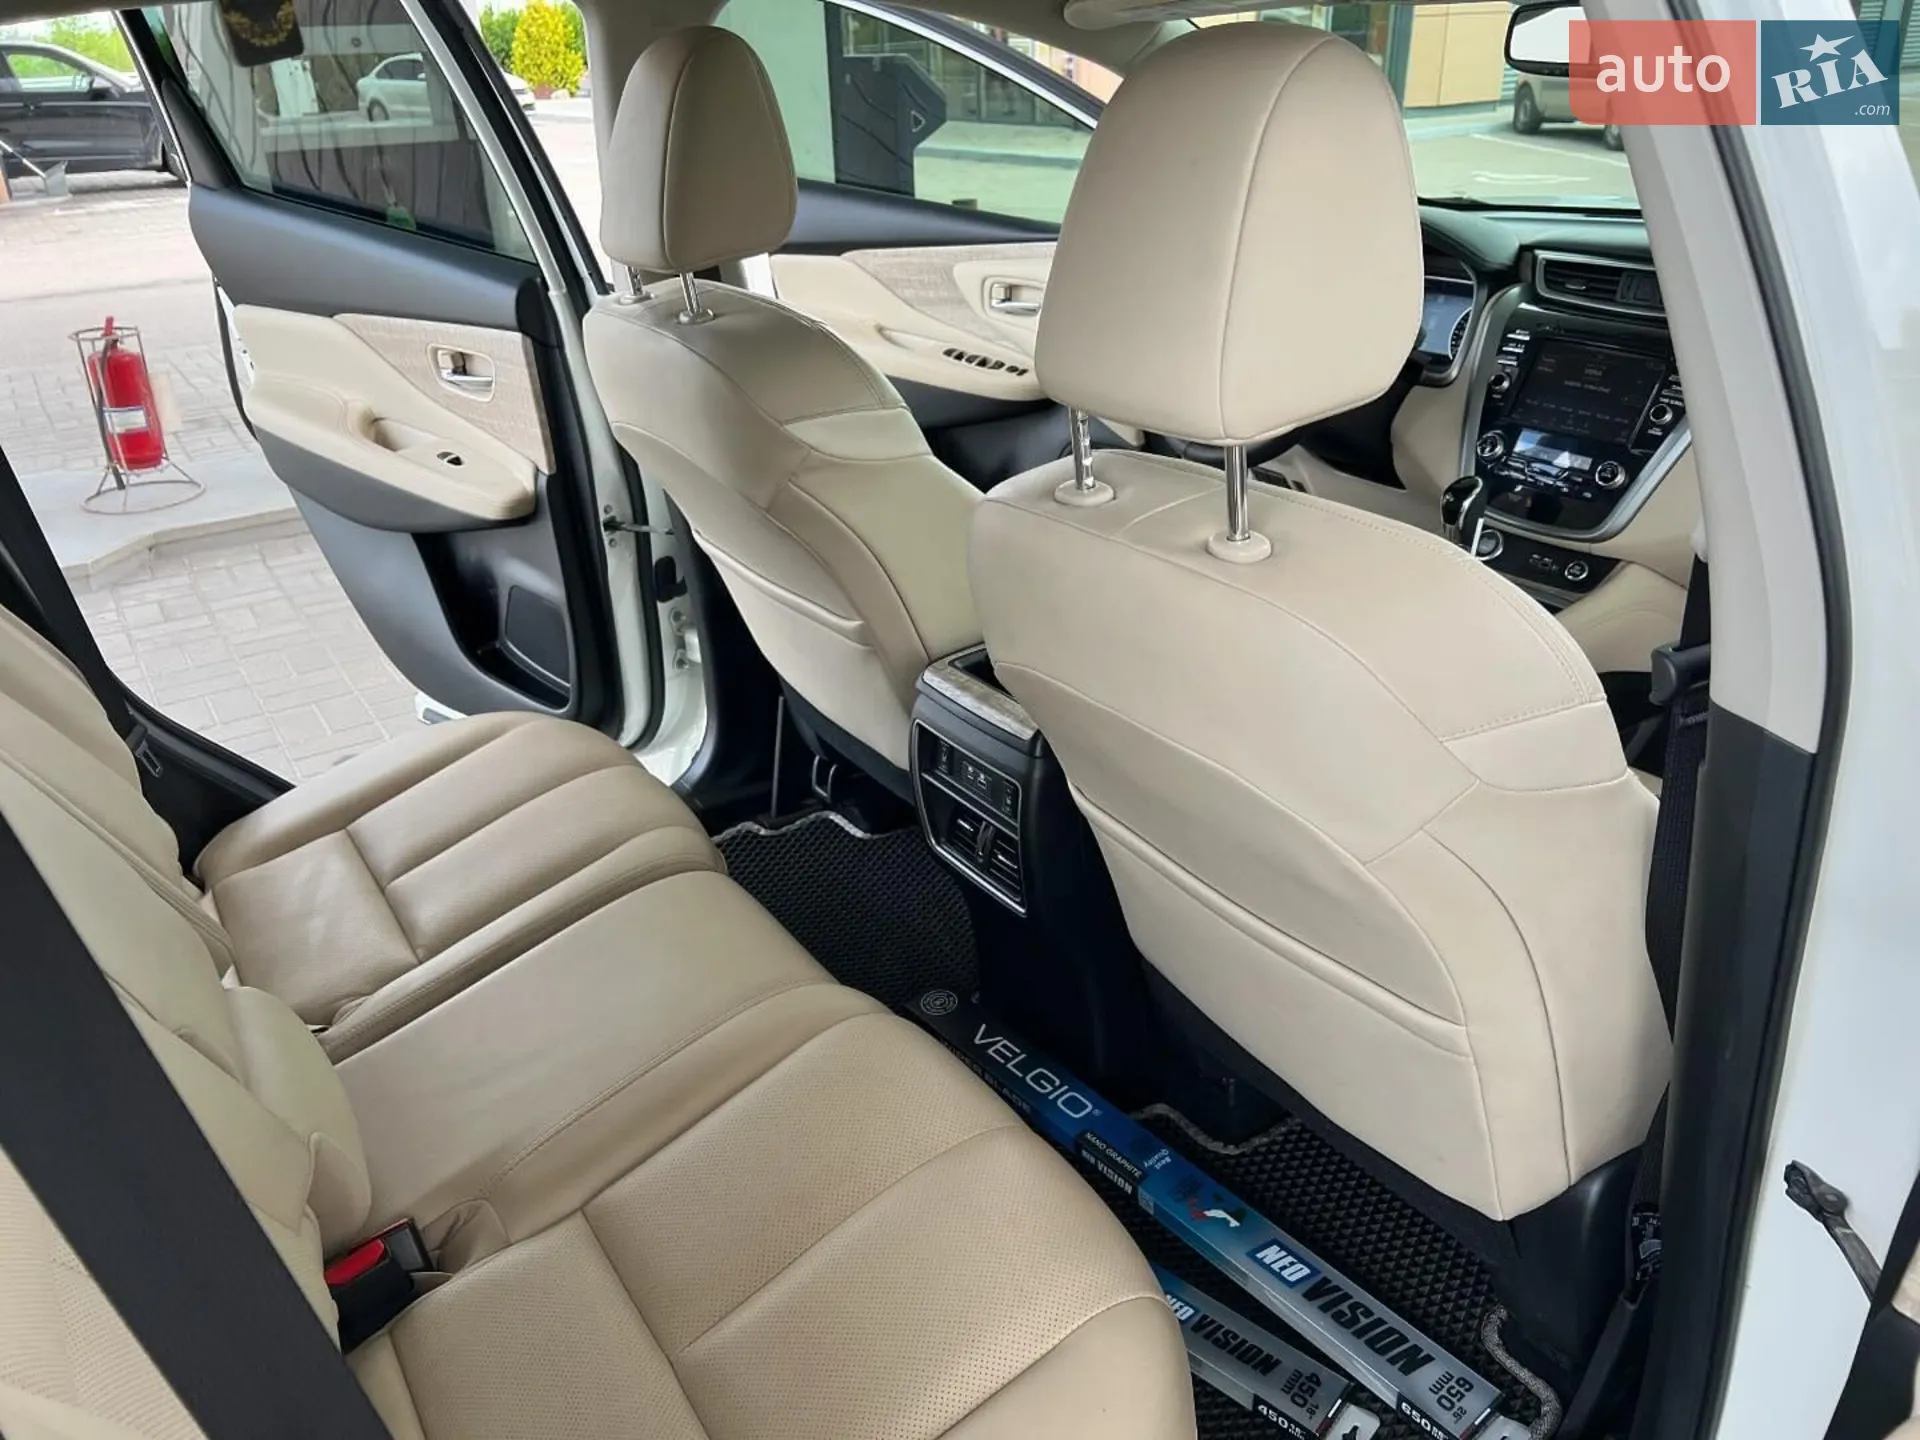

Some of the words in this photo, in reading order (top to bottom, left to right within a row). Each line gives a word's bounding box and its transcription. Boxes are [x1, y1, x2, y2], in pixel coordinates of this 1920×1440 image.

[973, 1023, 1093, 1119] VELGIO
[1105, 1148, 1142, 1178] GRAPHITE
[1255, 1244, 1311, 1283] NEO
[1301, 1276, 1435, 1377] VISION
[1190, 1313, 1283, 1377] VISION
[1280, 1368, 1304, 1395] mm
[1290, 1372, 1322, 1409] 450
[1429, 1371, 1455, 1395] mm
[1436, 1376, 1475, 1411] 650
[1257, 1404, 1288, 1429] 450
[1401, 1401, 1431, 1431] 650
